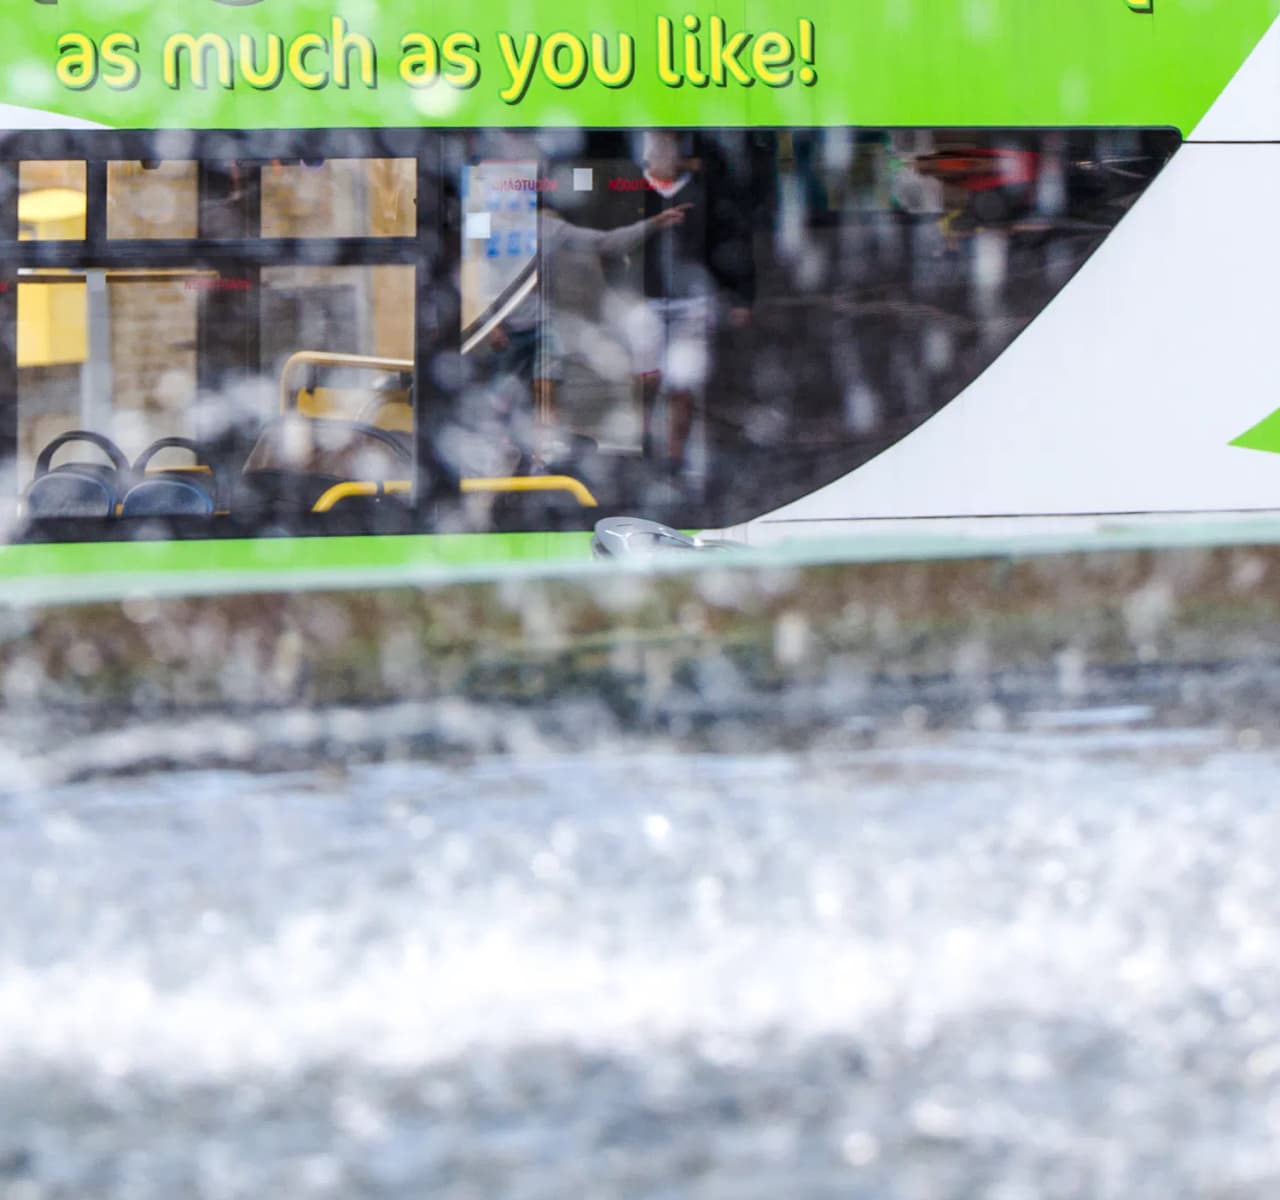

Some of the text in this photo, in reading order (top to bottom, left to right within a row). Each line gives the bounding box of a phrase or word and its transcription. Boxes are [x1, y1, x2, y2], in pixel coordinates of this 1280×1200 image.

[56, 15, 817, 105] as much as you like!
